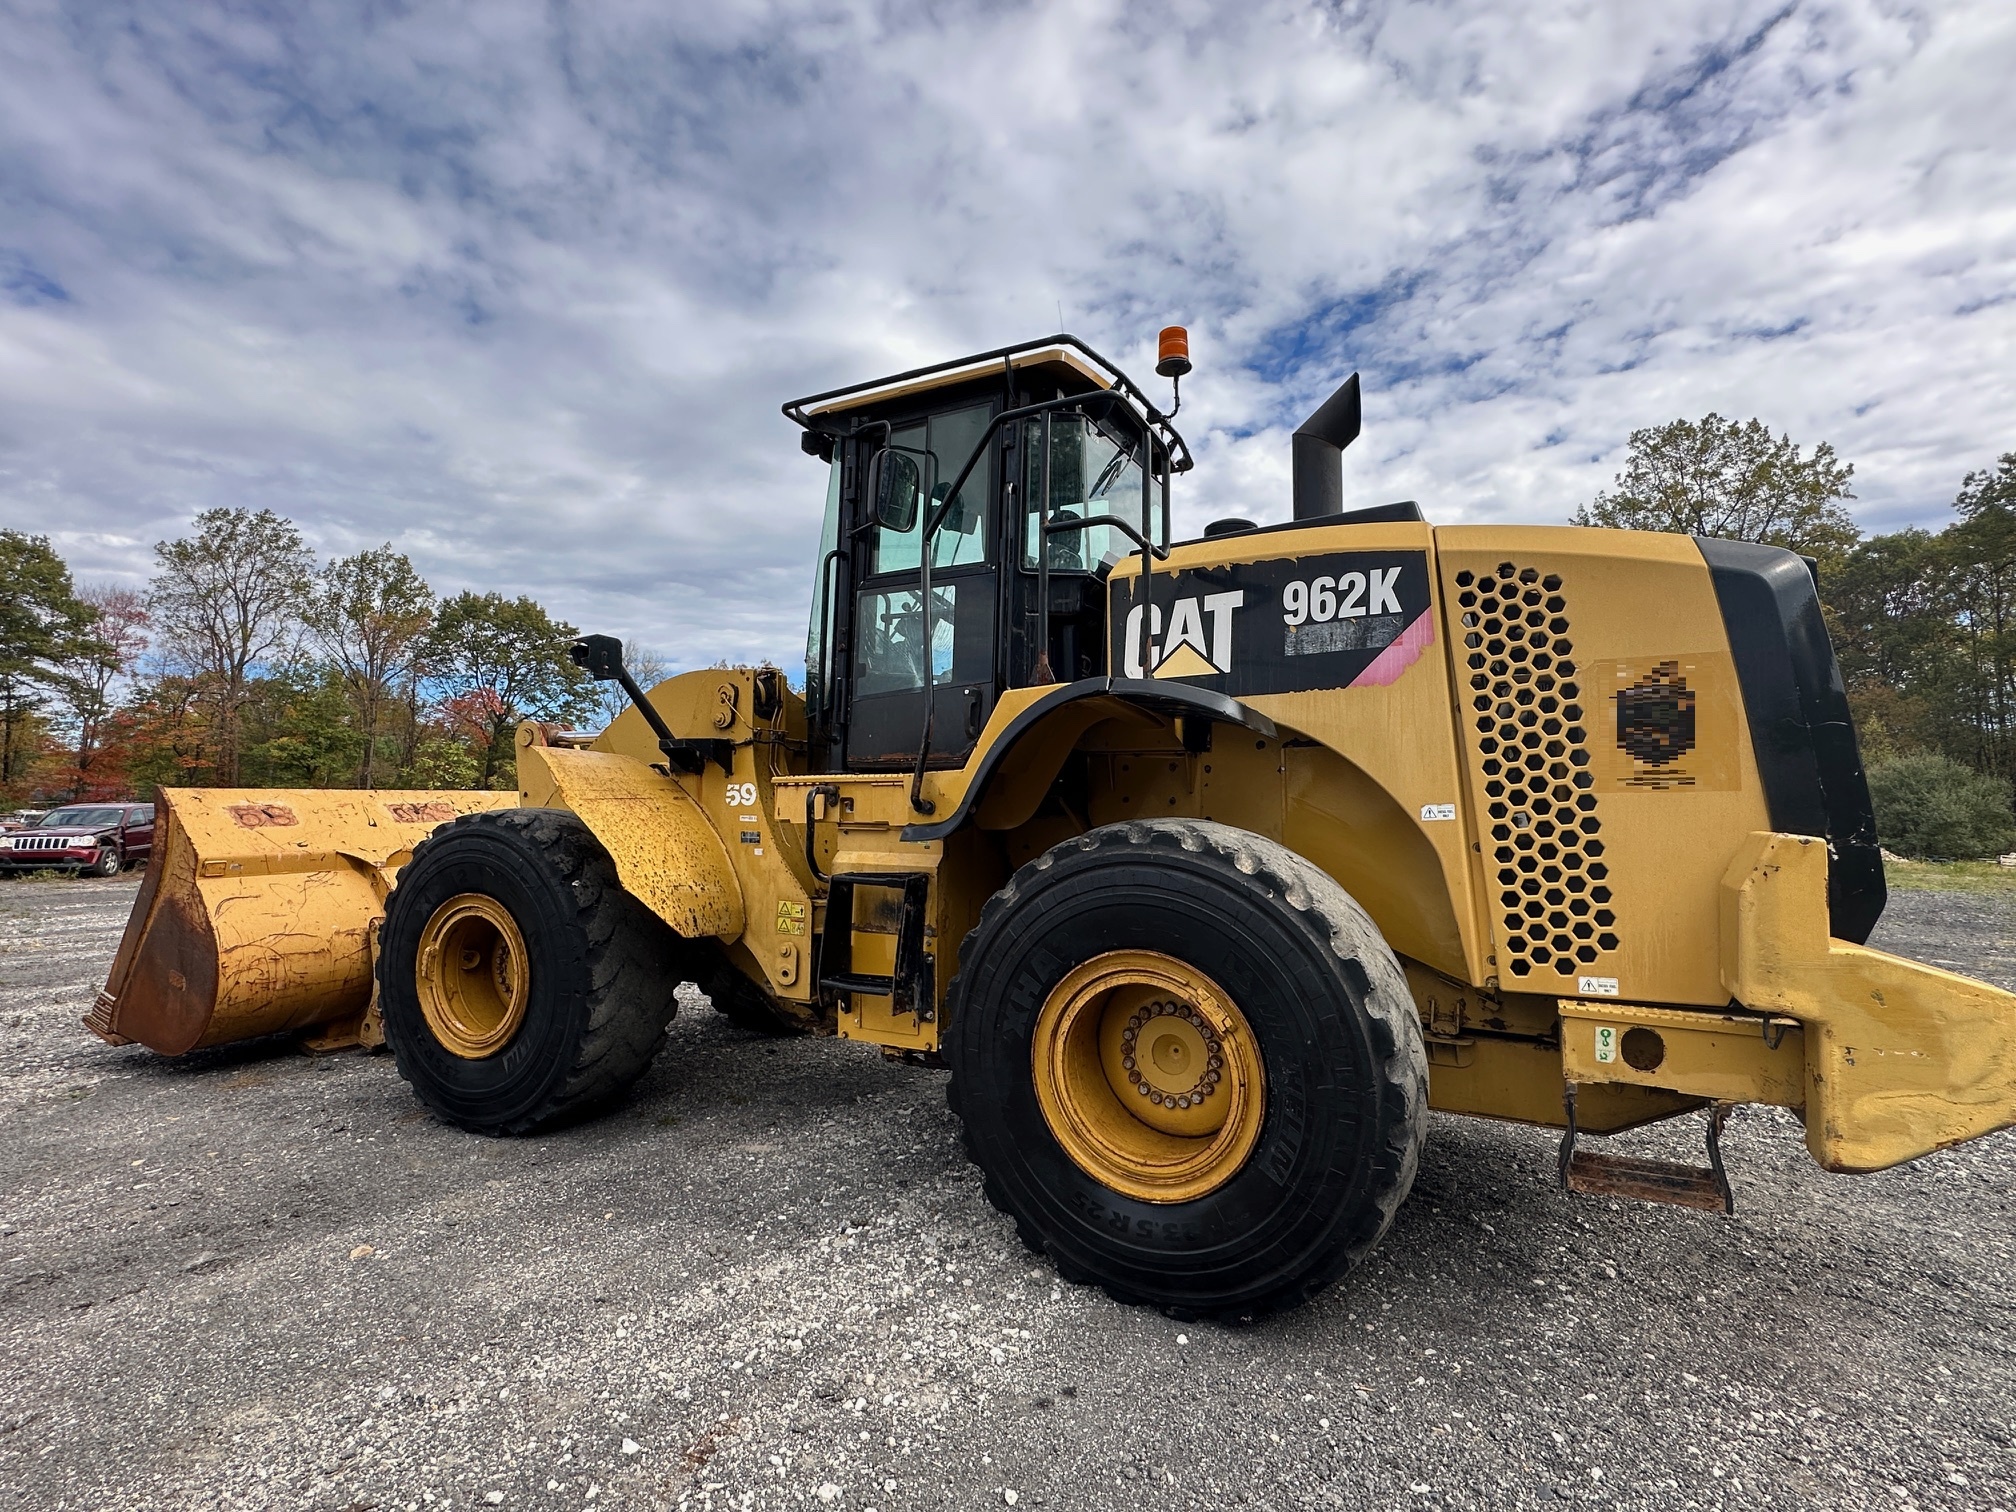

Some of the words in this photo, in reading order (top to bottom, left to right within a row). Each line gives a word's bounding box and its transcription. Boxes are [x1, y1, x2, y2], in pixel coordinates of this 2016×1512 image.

[1282, 566, 1403, 626] 962K
[1123, 589, 1244, 680] CAT
[725, 782, 757, 807] 59
[1001, 946, 1063, 1040] XHA
[1070, 1190, 1105, 1220] 25
[1108, 1210, 1131, 1233] R
